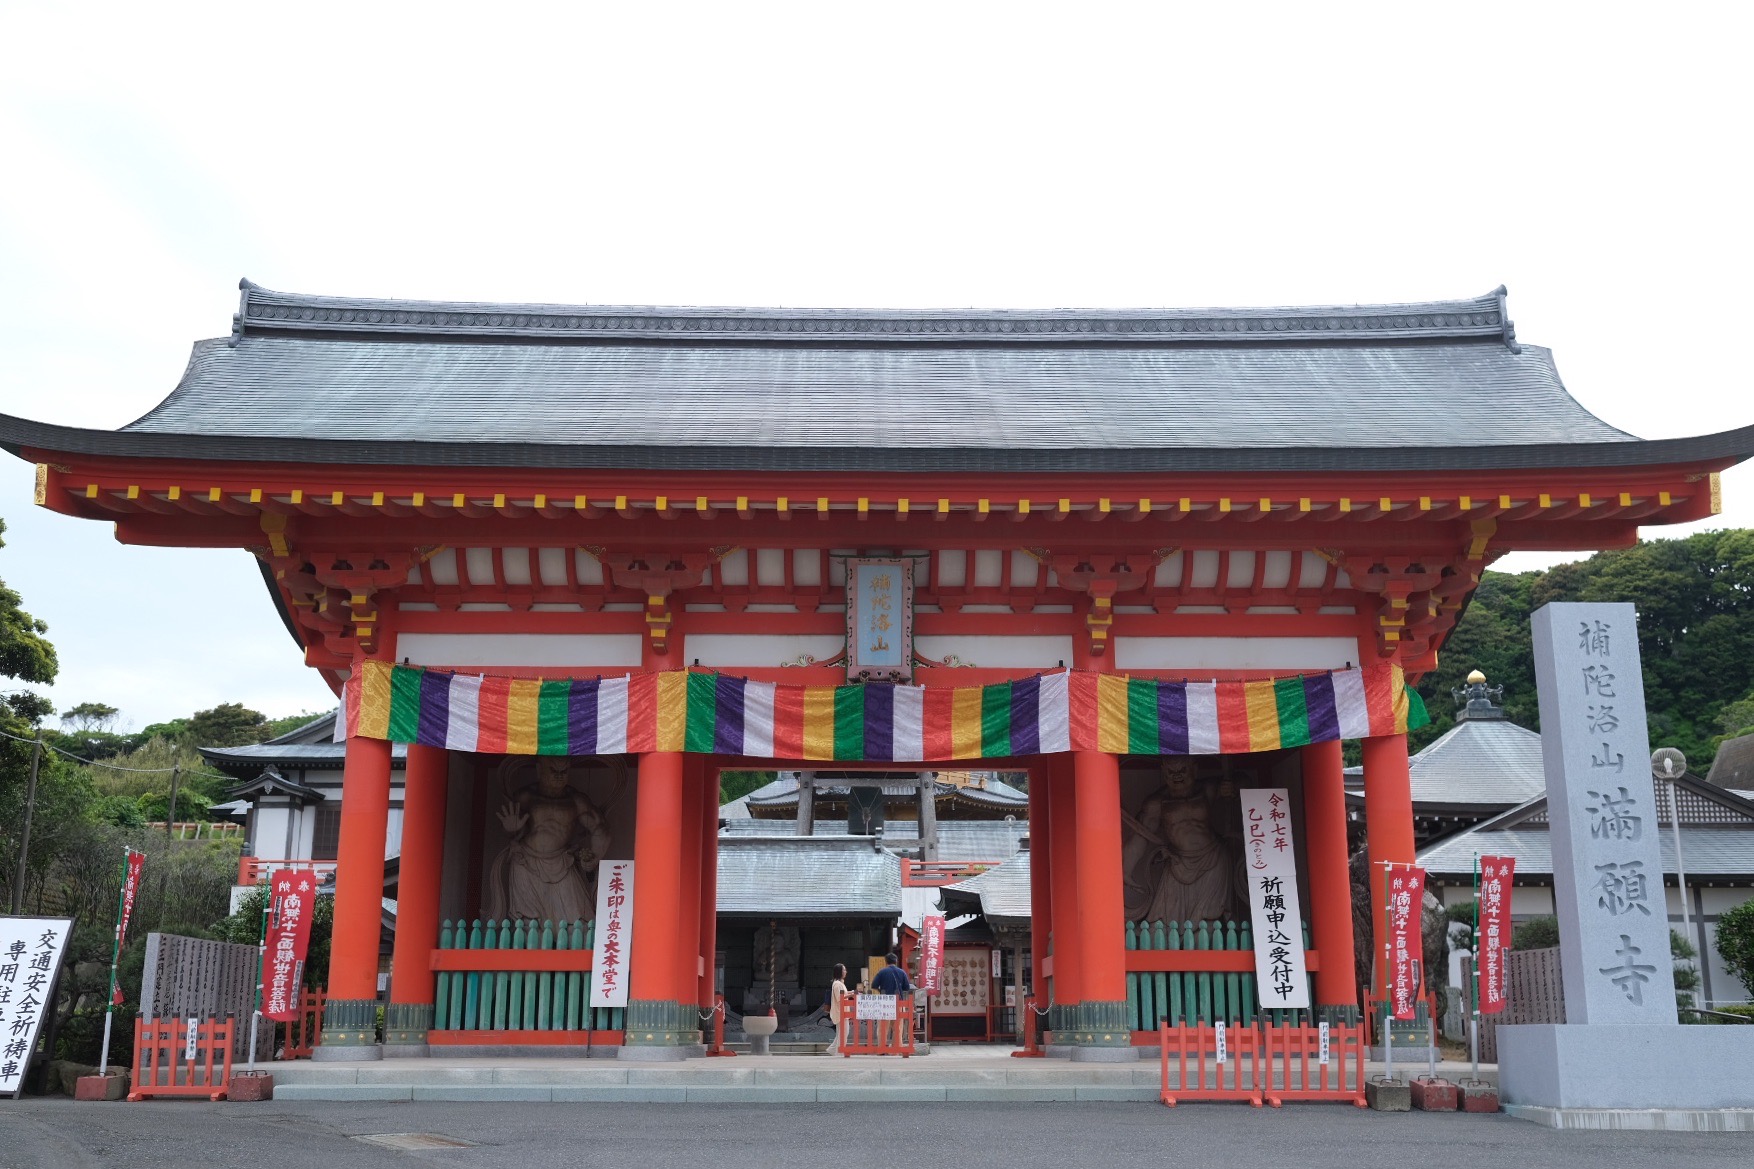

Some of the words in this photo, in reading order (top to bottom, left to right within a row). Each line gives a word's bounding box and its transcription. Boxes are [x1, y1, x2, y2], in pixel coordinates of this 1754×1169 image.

[870, 574, 893, 652] 補陀洛山
[1268, 793, 1288, 852] 令和七年
[0, 940, 27, 1022] 専用駐
[601, 863, 628, 999] ご朱印は奥の大本堂で
[1260, 876, 1294, 1001] 祈願申込受付中
[0, 929, 58, 1083] 交通安全祈祷車
